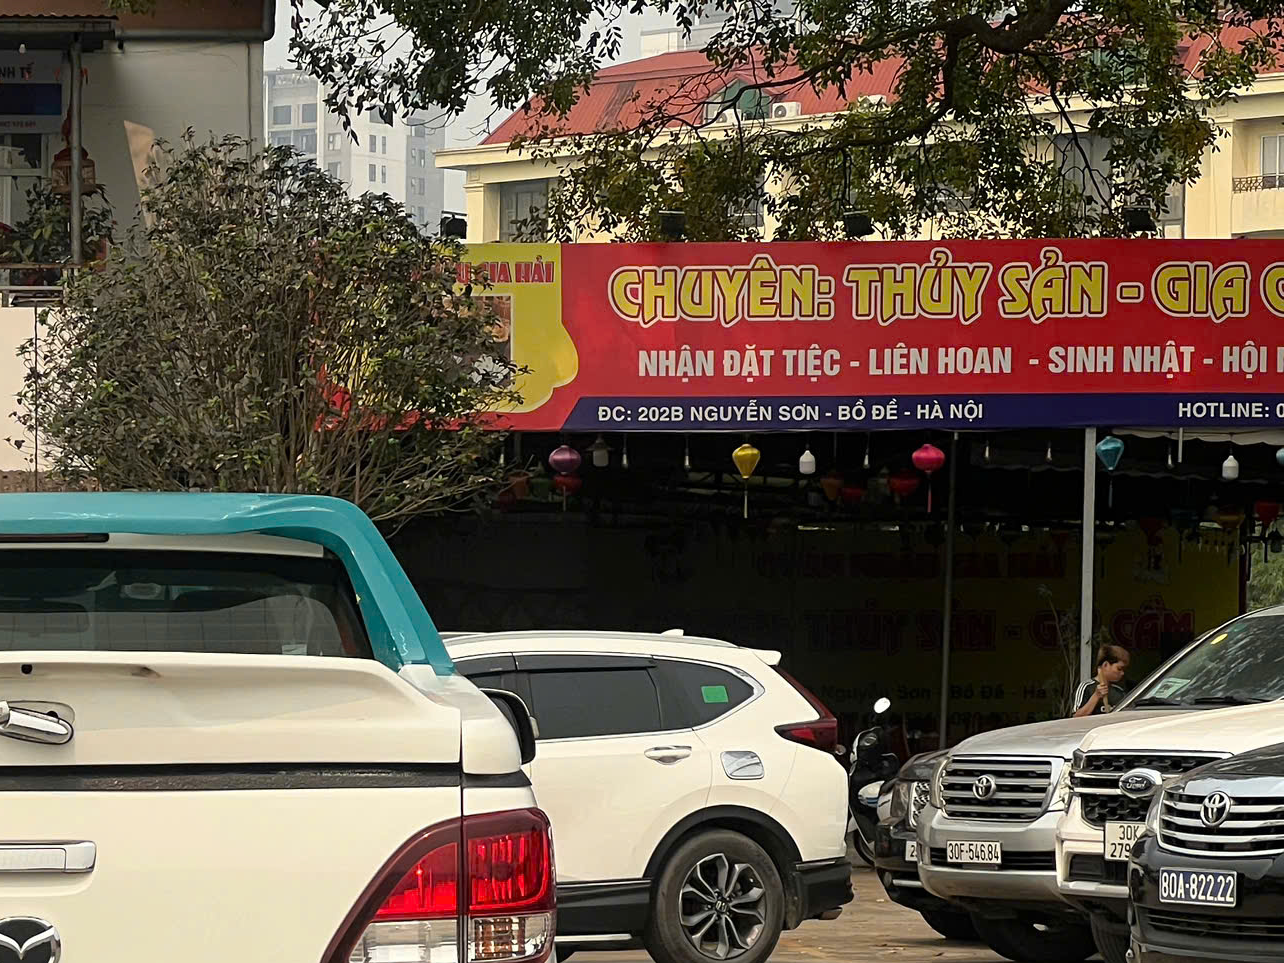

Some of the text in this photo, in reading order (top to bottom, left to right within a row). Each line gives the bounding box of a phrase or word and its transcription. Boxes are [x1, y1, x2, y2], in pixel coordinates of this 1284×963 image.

[515, 255, 554, 284] HẢI
[608, 255, 834, 327] CHUYÊN:
[843, 248, 992, 326] THỦY
[999, 247, 1108, 324] SẢN
[1151, 260, 1251, 323] GIA
[638, 344, 714, 383] NHẬN
[723, 343, 775, 383] ĐẶT
[782, 344, 840, 382] TIỆC
[869, 343, 928, 376] LIÊN
[938, 346, 1012, 374] HOAN
[1048, 345, 1113, 373] SINH
[1123, 340, 1195, 379] NHẬT
[1222, 340, 1267, 379] HỘI
[597, 406, 632, 422] ĐC:
[638, 405, 684, 422] 202B
[690, 399, 773, 422] NGUYỄN
[778, 404, 819, 421] SƠN
[838, 398, 866, 421] BỒ
[871, 399, 898, 421] ĐỀ
[916, 400, 944, 420] HÀ
[949, 399, 983, 422] NỘI
[1178, 402, 1269, 418] HOTLINE:
[1119, 825, 1140, 841] 30K
[948, 843, 999, 861] 30F-546.84
[1161, 872, 1234, 902] 80A-822.22
